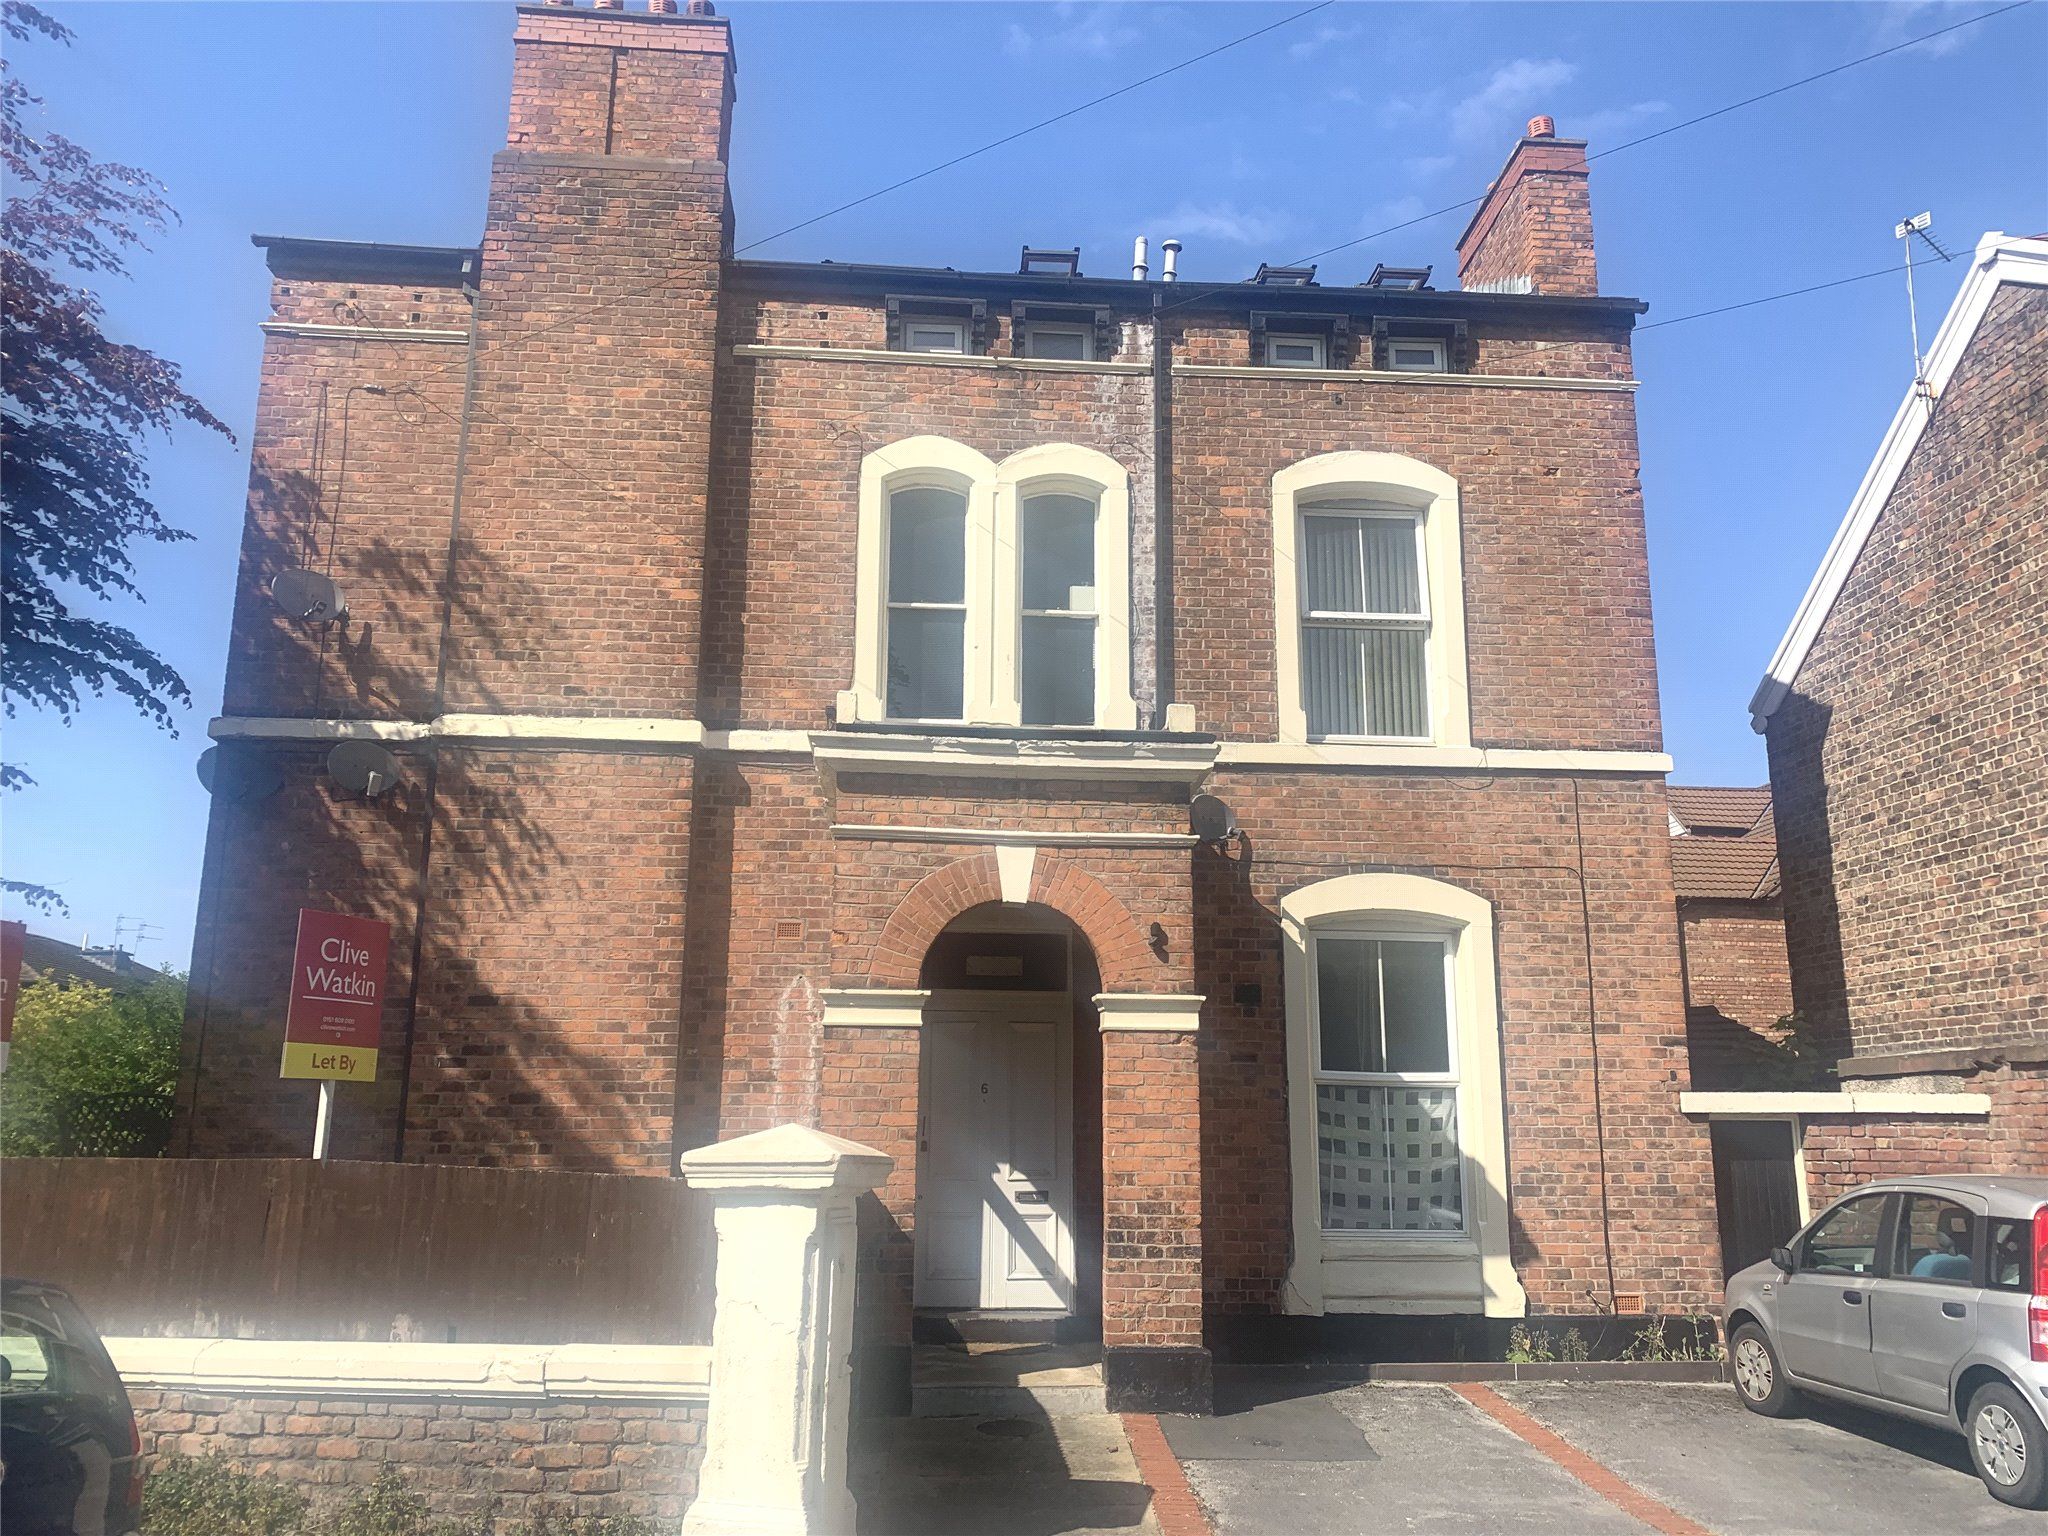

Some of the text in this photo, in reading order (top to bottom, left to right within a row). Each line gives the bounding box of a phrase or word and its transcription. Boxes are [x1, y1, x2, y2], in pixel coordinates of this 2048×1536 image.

[320, 937, 369, 967] Clive
[306, 966, 375, 998] Watkin
[312, 1052, 356, 1074] Let By
[980, 1083, 989, 1095] 6
